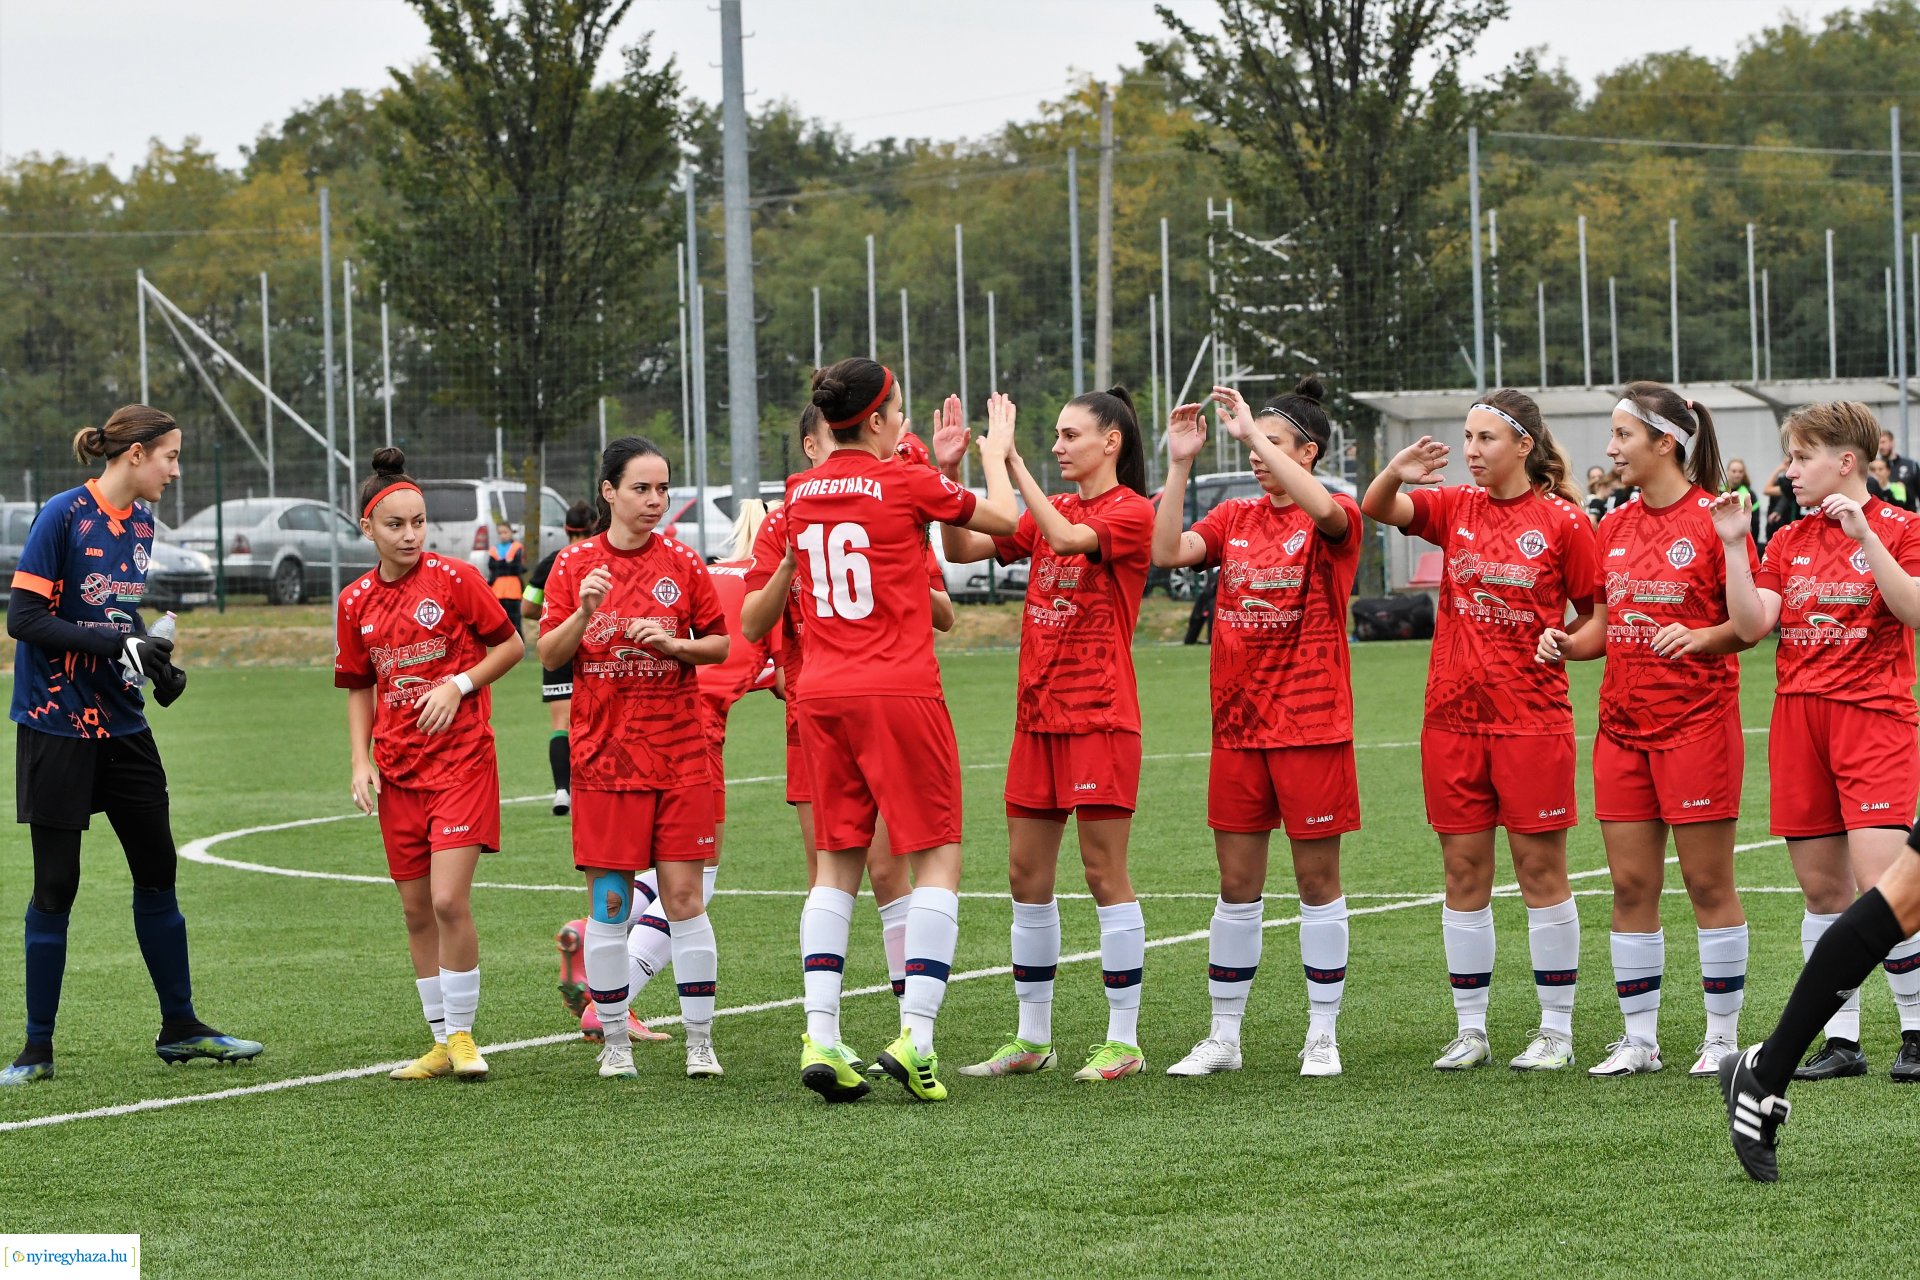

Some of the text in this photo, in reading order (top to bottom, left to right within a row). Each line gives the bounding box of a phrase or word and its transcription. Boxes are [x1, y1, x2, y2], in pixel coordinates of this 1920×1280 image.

[84, 547, 104, 558] JAKO
[796, 522, 875, 620] 16
[1474, 561, 1541, 582] REVESZ
[111, 581, 145, 595] REVES
[1625, 579, 1689, 597] REVESZ
[1811, 582, 1876, 598] REVESZ
[583, 660, 633, 673] LERTON
[1079, 782, 1097, 790] JAKO
[1691, 798, 1711, 807] JAKO
[1870, 802, 1890, 810] JAKO
[1548, 807, 1566, 817] JAKO
[1315, 814, 1334, 823] JAKO
[451, 825, 470, 833] JAKO
[805, 957, 839, 967] JAKO
